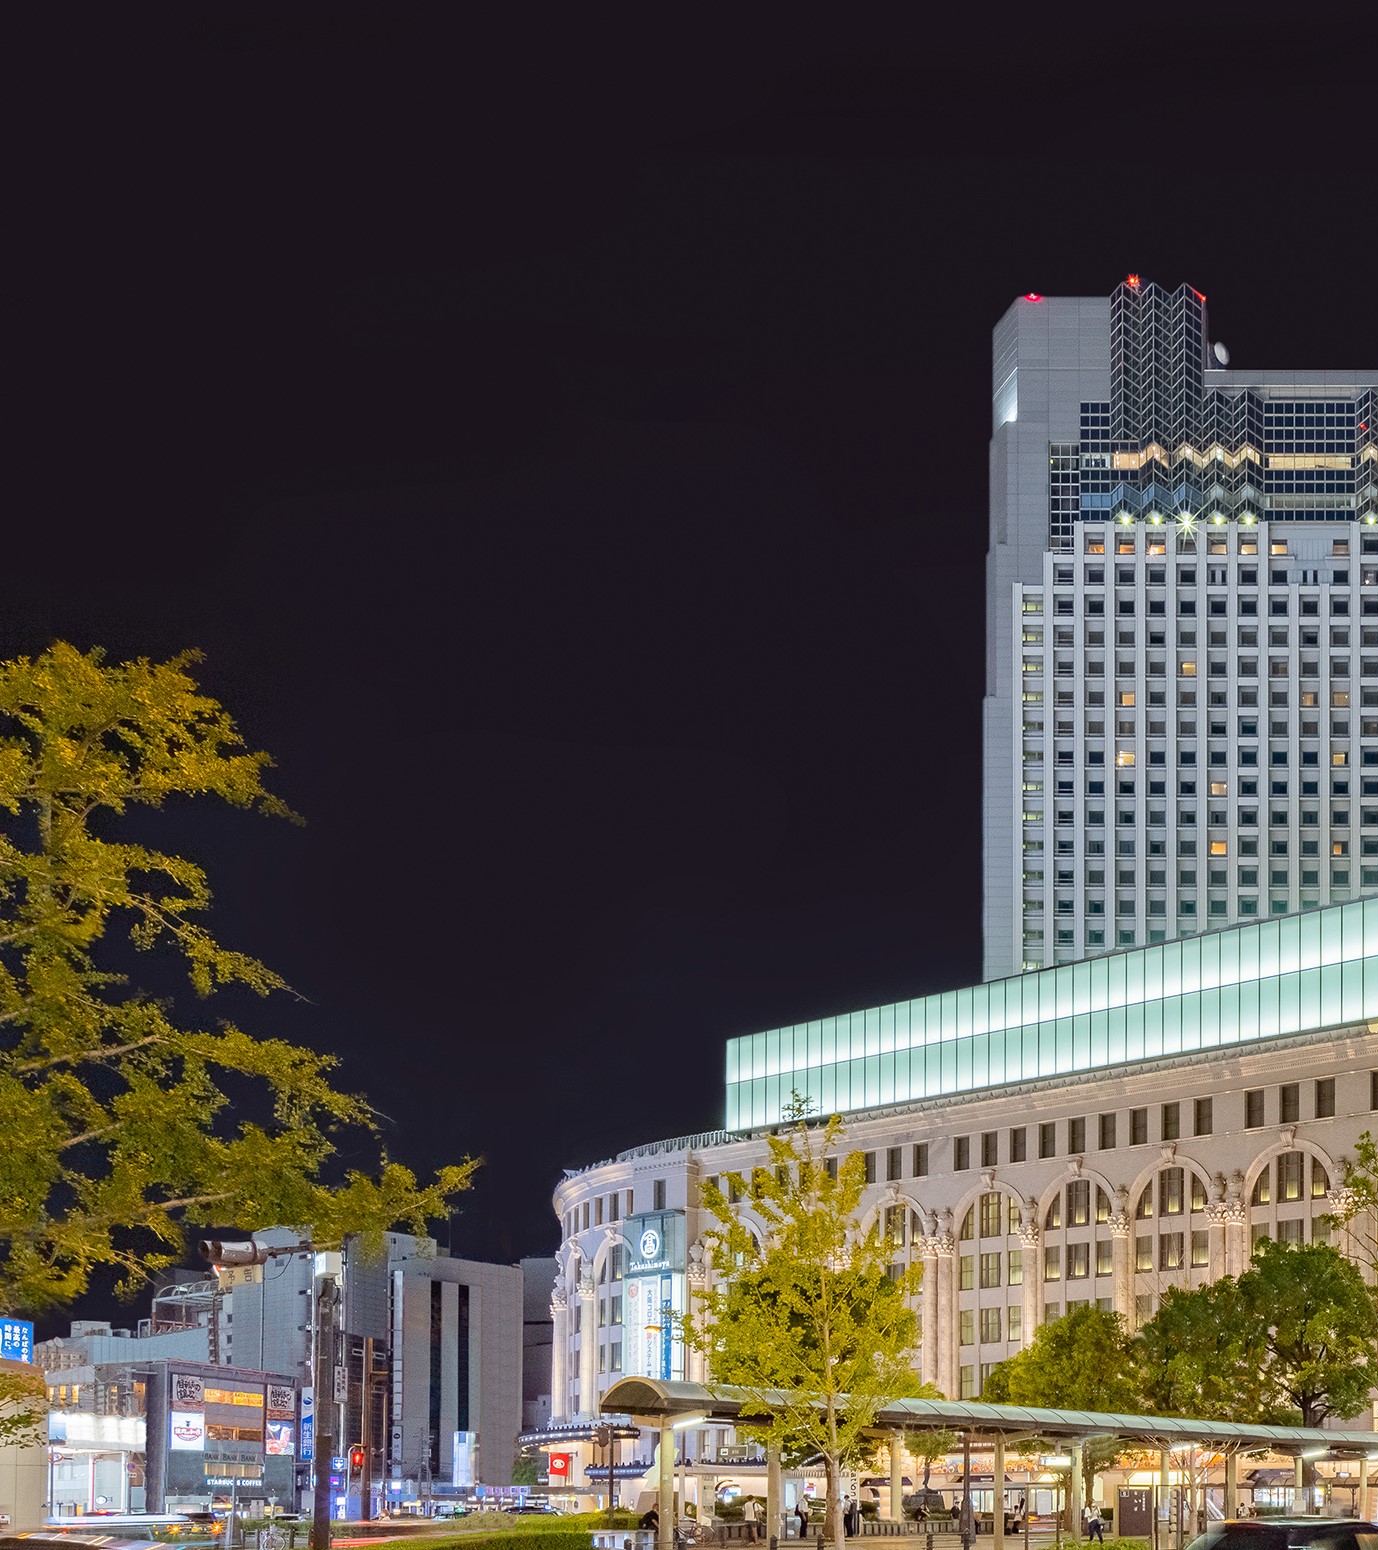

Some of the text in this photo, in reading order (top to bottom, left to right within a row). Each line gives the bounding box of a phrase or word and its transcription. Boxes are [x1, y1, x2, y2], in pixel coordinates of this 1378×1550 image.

[629, 1260, 670, 1271] Takashimaya
[303, 1422, 312, 1456] 新生銀行
[206, 1478, 262, 1487] STARBUCS COFFEE
